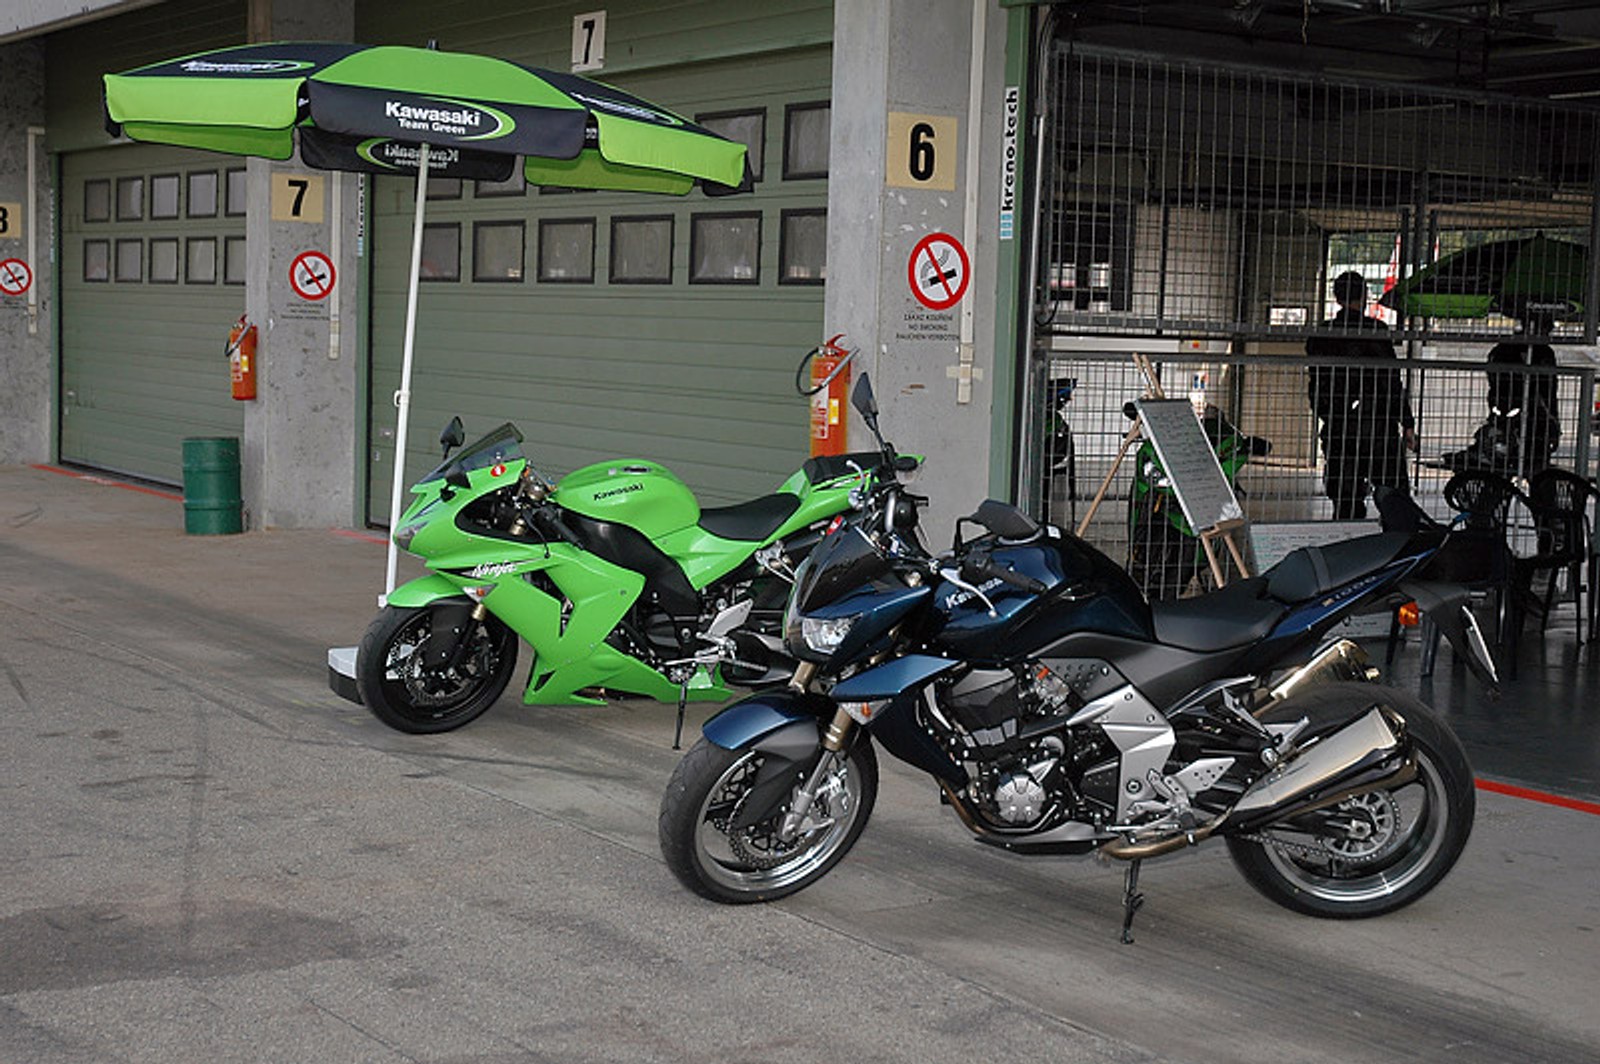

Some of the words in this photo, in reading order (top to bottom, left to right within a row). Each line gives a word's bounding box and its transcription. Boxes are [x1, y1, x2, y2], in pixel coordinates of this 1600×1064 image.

[582, 19, 595, 65] 7
[385, 101, 481, 126] Kawasaki
[399, 118, 429, 131] Team
[432, 121, 466, 135] Green
[909, 122, 936, 181] 6
[287, 180, 308, 217] 7
[594, 482, 643, 501] Kawasaki
